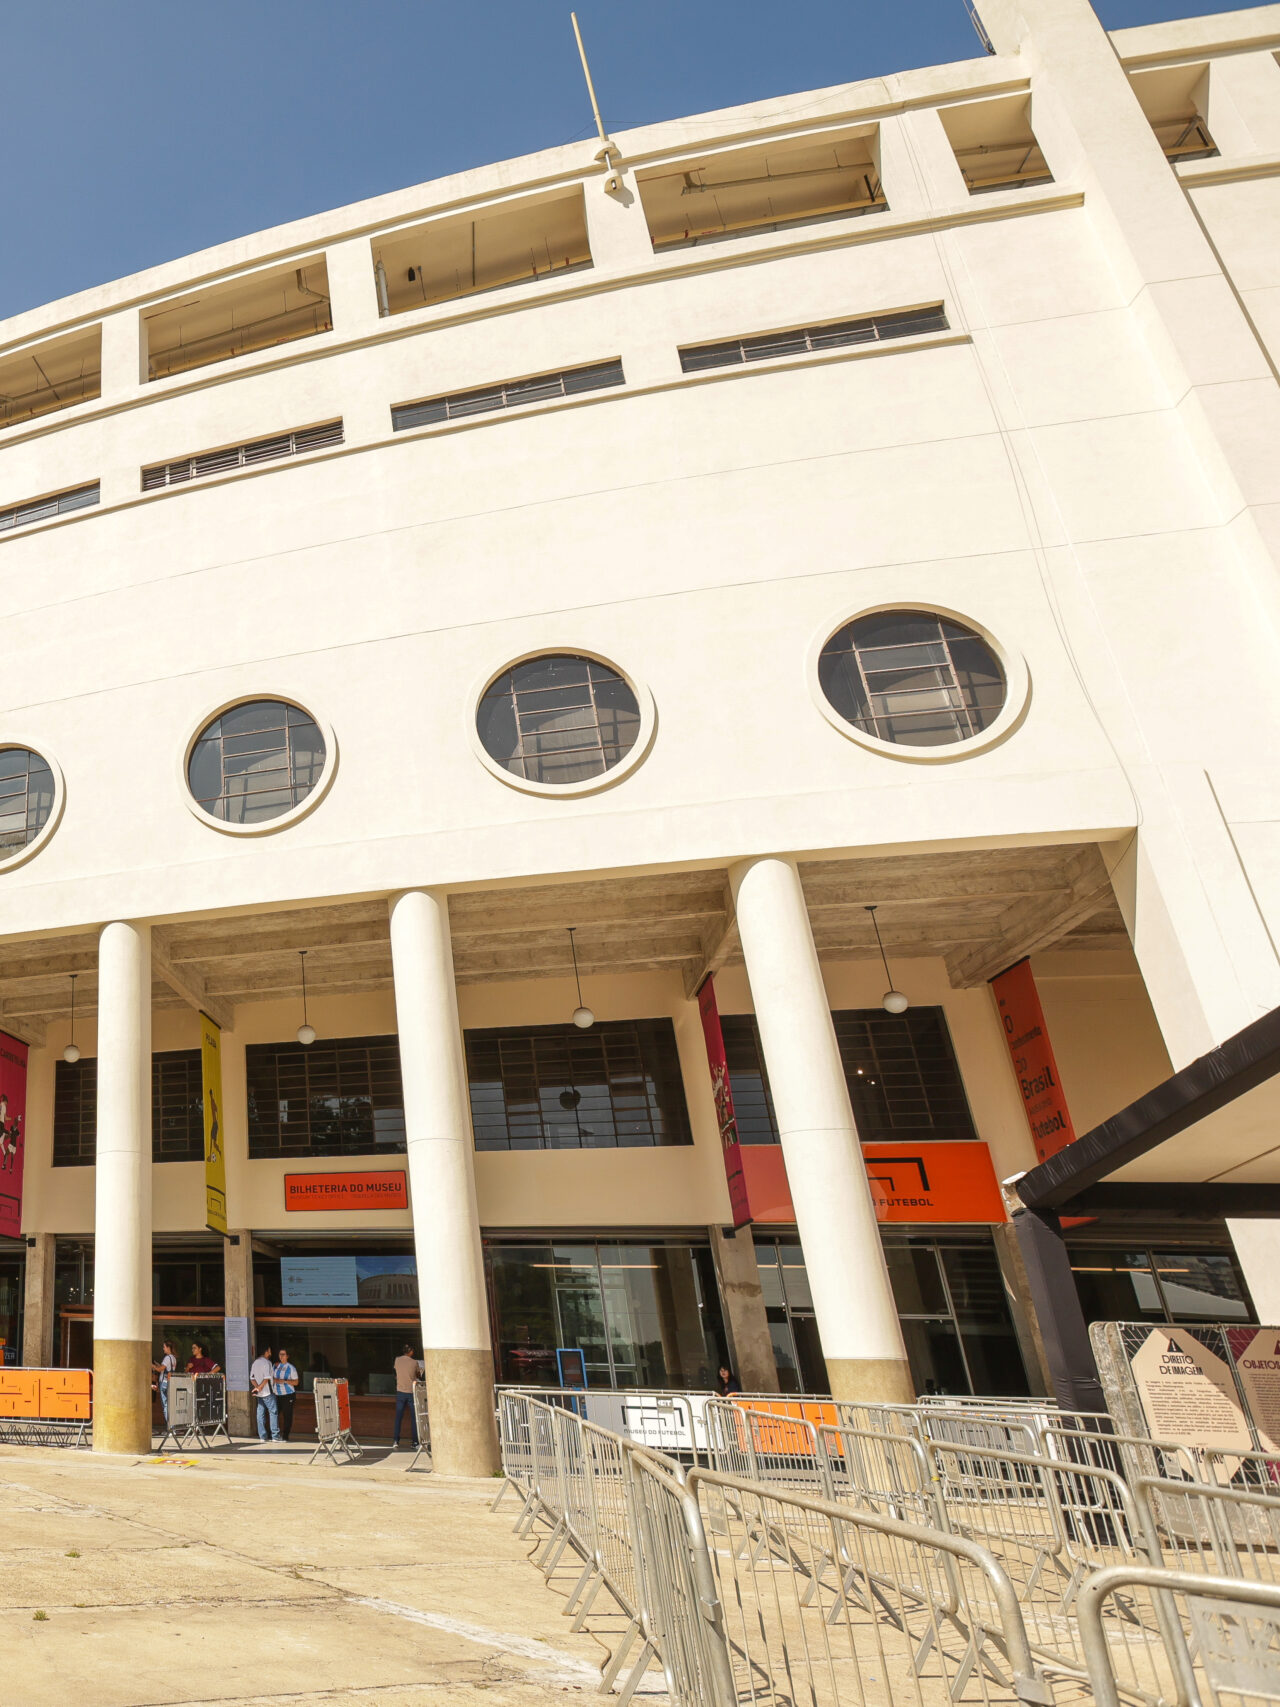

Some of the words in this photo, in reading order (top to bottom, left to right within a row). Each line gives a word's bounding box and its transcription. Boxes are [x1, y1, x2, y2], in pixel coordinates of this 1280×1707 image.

[1021, 1066, 1055, 1100] Brasil
[289, 1184, 348, 1194] BILHETERIA
[350, 1183, 364, 1193] DO
[366, 1182, 402, 1192] MUSEU
[880, 1198, 935, 1207] FUTEBOL
[1161, 1354, 1194, 1365] DIREITO
[1159, 1365, 1172, 1375] DE
[1172, 1366, 1204, 1376] IMAGEM
[623, 1428, 647, 1436] MUSEU
[658, 1429, 686, 1437] FUTEBOL
